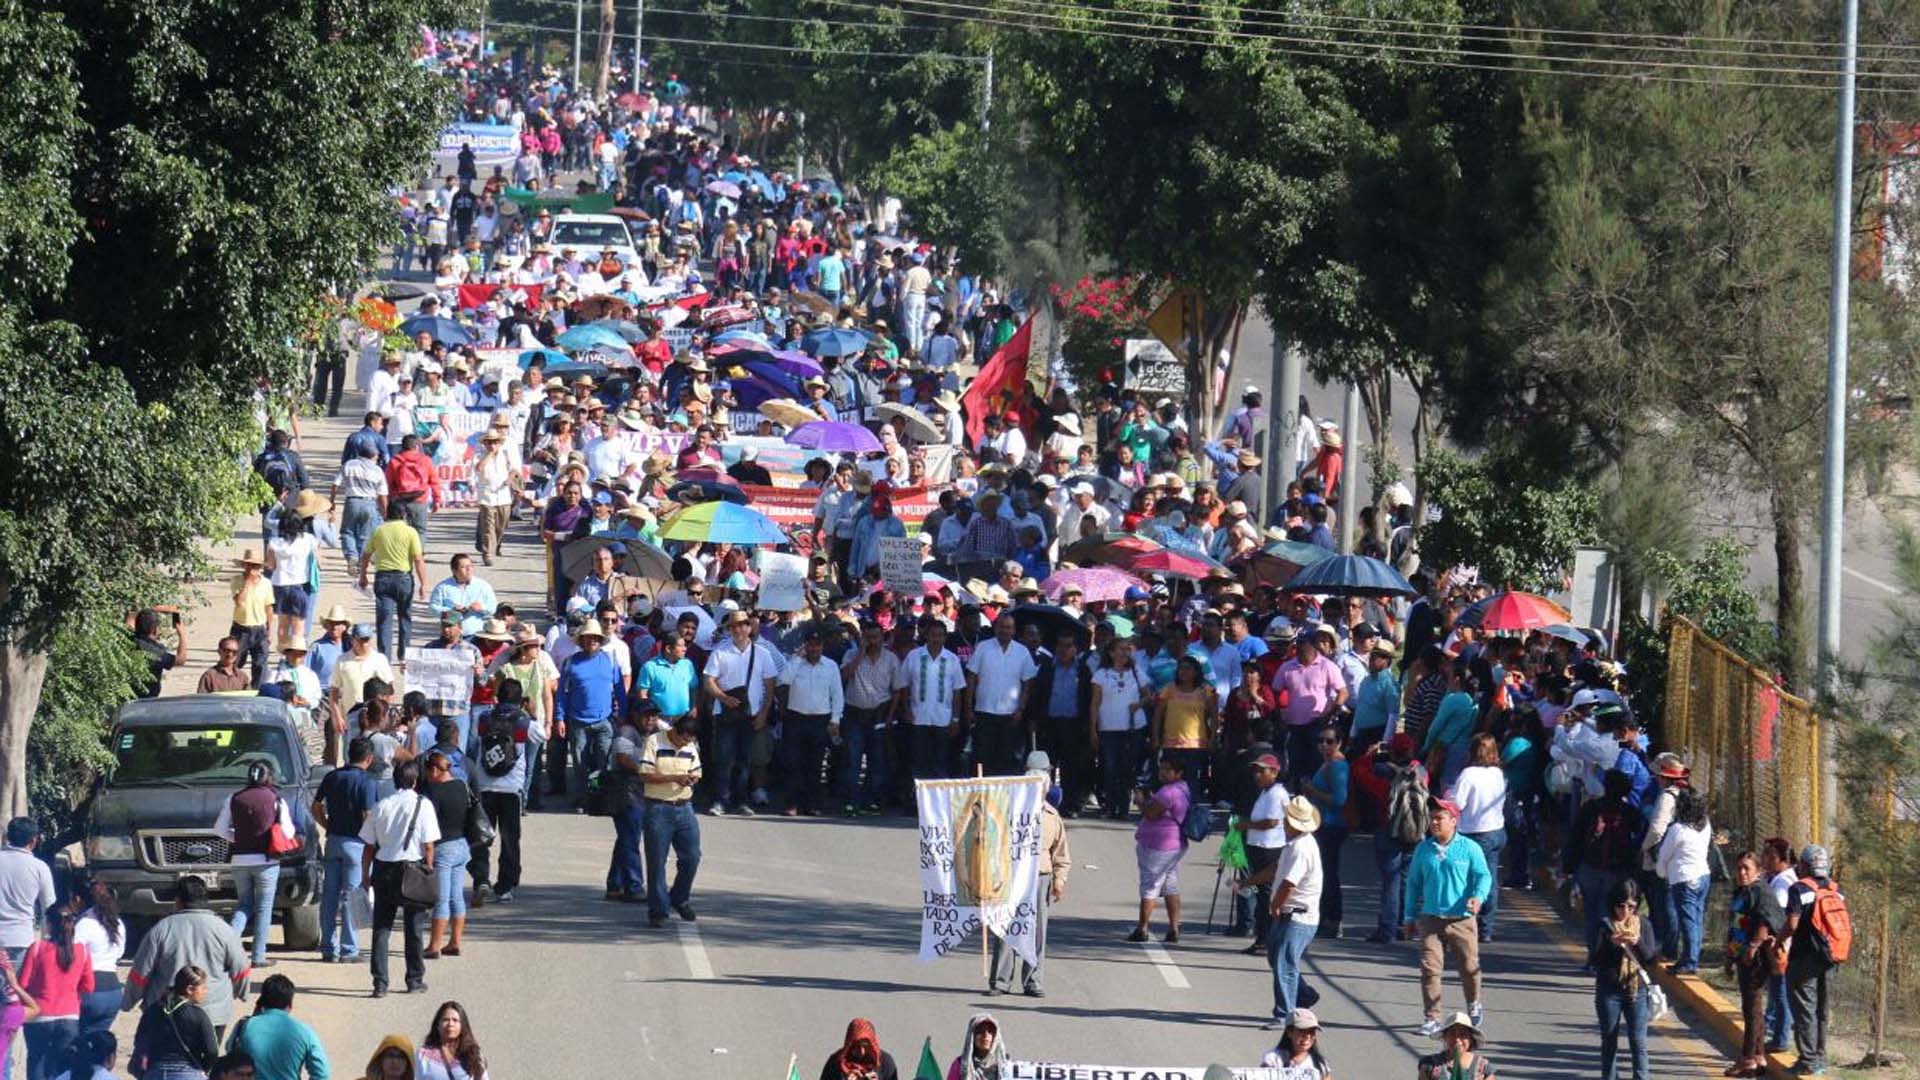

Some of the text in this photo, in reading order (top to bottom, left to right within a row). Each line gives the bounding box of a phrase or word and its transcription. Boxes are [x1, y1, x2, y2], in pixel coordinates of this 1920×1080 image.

[923, 889, 957, 907] LIBER
[923, 906, 959, 922] TADO
[933, 921, 955, 937] RA
[933, 913, 981, 957] DE LOS
